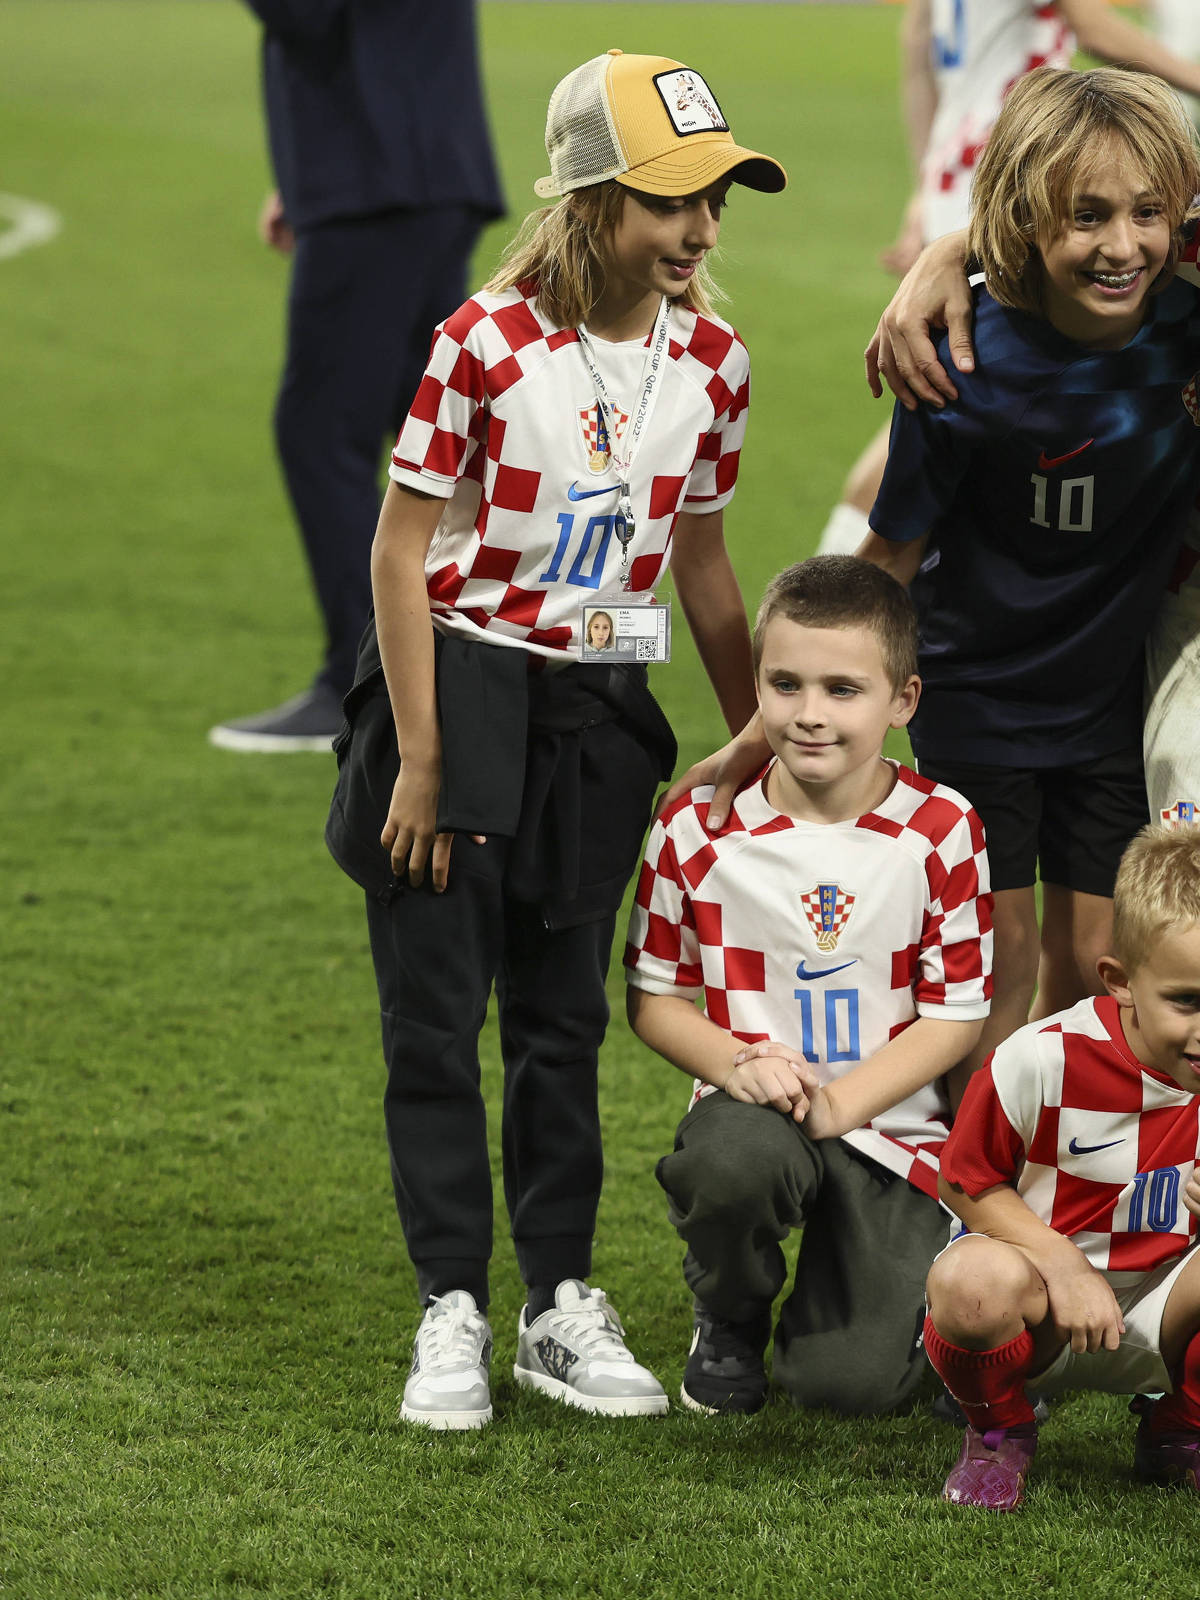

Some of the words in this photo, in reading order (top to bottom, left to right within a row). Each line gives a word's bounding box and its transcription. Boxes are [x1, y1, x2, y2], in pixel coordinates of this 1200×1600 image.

[1030, 473, 1095, 532] 10
[539, 512, 617, 590] 10
[823, 890, 833, 925] HNS
[794, 988, 861, 1063] 10
[1127, 1166, 1181, 1233] 10
